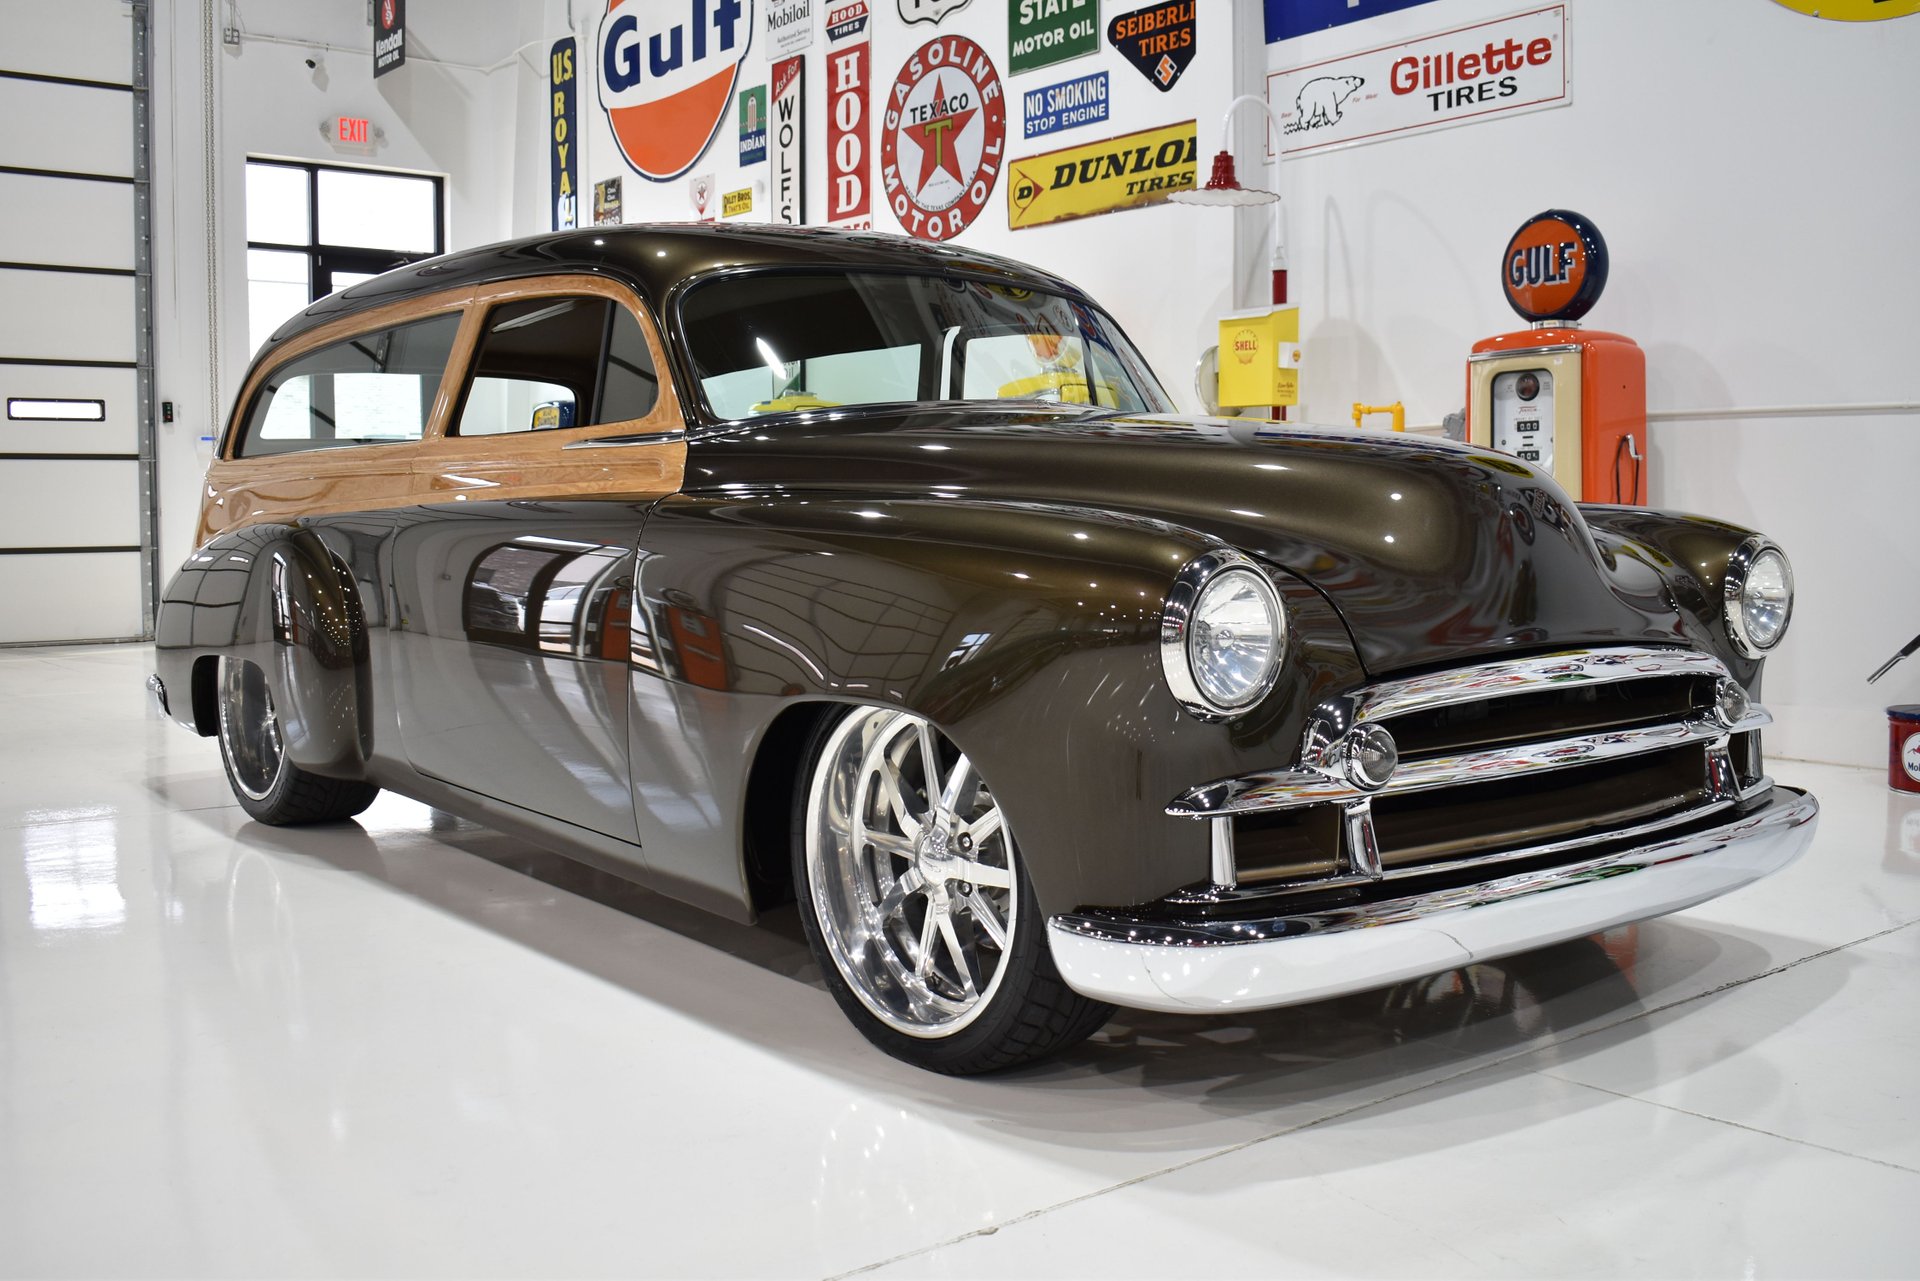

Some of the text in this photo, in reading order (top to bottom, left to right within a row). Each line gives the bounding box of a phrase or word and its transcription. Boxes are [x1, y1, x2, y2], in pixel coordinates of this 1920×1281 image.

[768, 0, 810, 32] Mobiloil
[832, 4, 863, 24] HOOD
[834, 21, 860, 36] TIRES
[376, 28, 403, 58] Kendall
[604, 0, 742, 93] Gulf
[1012, 19, 1095, 57] MOTOR OIL
[1139, 28, 1191, 57] TIRES
[378, 49, 400, 68] MOTOR OIL
[552, 48, 574, 86] U.S.
[1390, 36, 1552, 96] Gillette
[776, 72, 787, 97] Ask
[787, 60, 799, 80] For
[886, 40, 999, 132] GASOLINE
[1427, 75, 1518, 112] TIRES
[910, 92, 969, 124] TEXACO
[1026, 76, 1106, 118] NO SMOKING
[338, 116, 369, 143] EXIT
[835, 51, 862, 214] HOOD
[1027, 103, 1106, 135] STOP ENGINE
[553, 91, 574, 226] ROYAL
[740, 134, 766, 153] INDIAN
[884, 137, 1001, 239] MOTOR OIL
[1127, 170, 1195, 196] TIRES
[1509, 242, 1575, 288] GULF
[1235, 341, 1257, 351] SHELL
